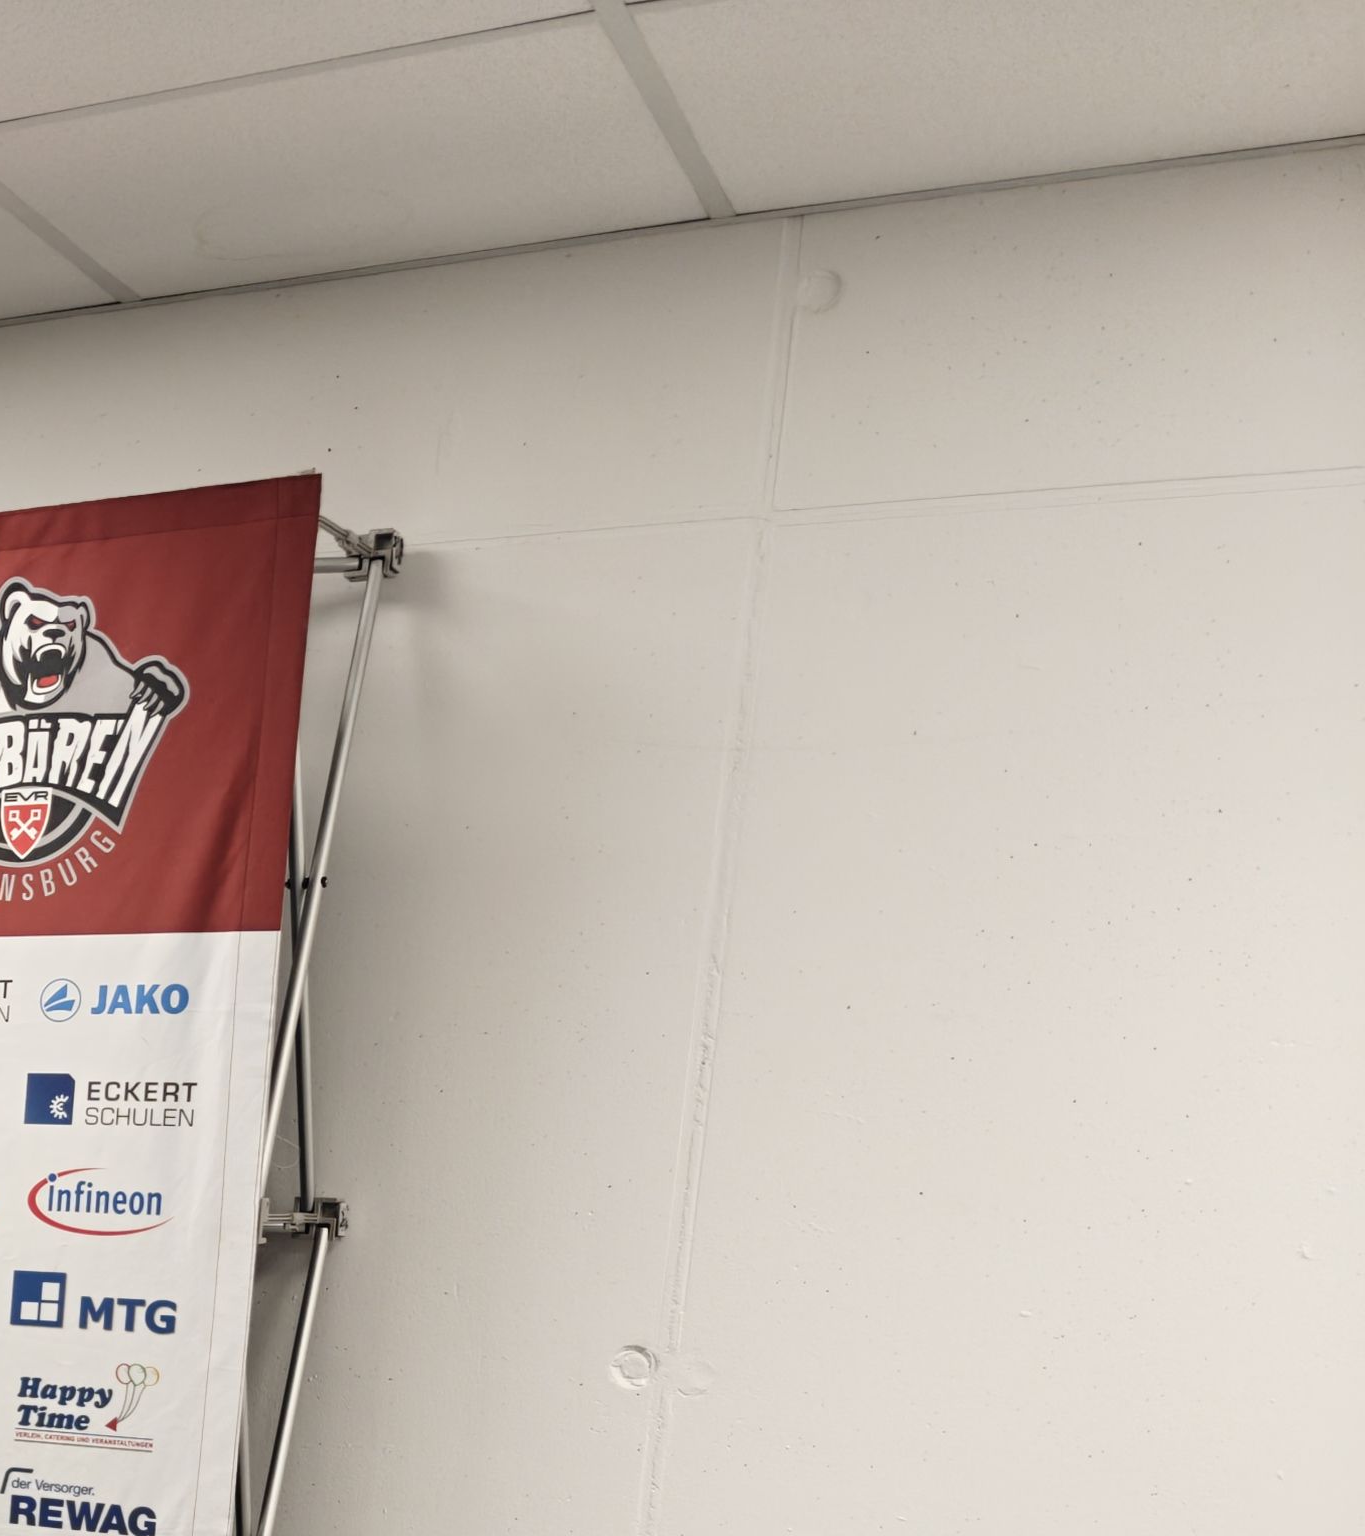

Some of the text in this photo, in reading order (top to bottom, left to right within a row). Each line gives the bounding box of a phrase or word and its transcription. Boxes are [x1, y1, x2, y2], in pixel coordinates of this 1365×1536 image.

[5, 791, 49, 800] EVR
[91, 984, 189, 1014] JAKO
[87, 1081, 197, 1103] ECKERT
[85, 1107, 195, 1127] SCHULEN
[79, 1296, 178, 1335] MTG
[17, 1377, 113, 1408] Happy
[17, 1405, 90, 1430] Time
[12, 1477, 32, 1490] der
